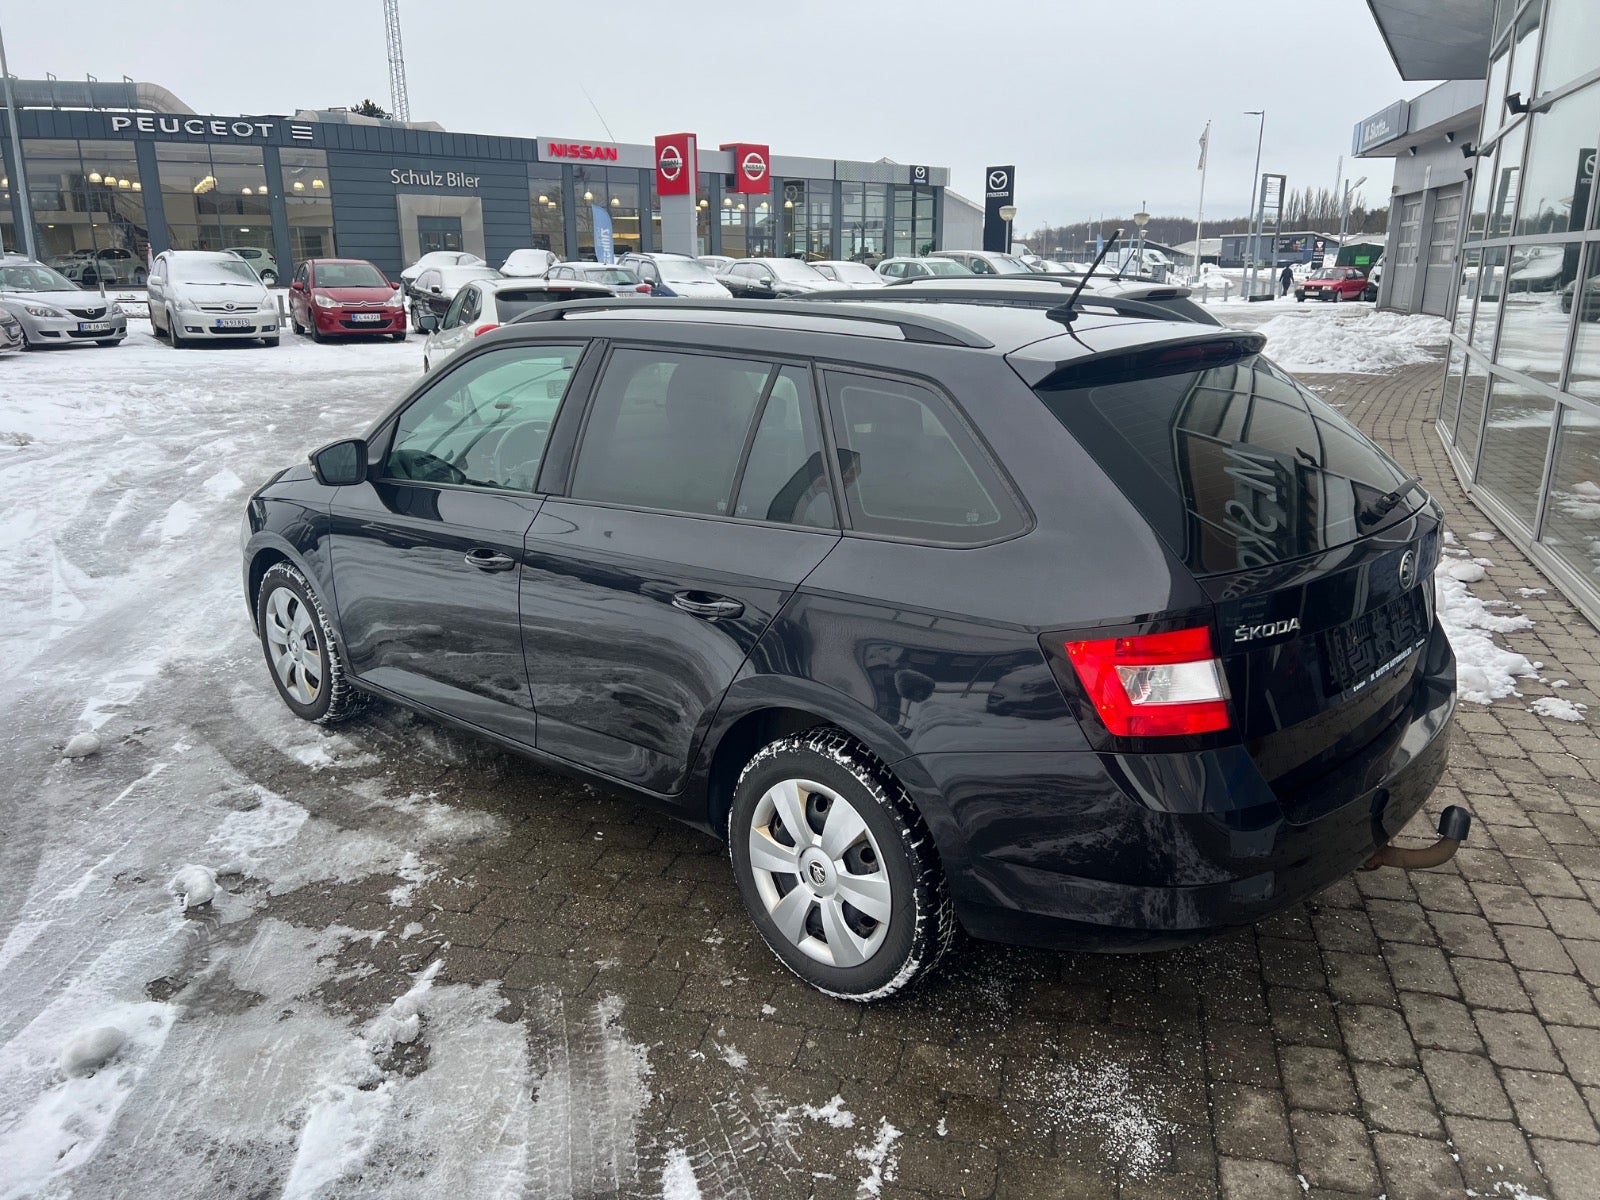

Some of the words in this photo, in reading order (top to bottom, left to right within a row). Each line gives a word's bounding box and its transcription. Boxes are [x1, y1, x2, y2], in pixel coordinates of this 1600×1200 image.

[111, 116, 273, 138] PEUGEOT
[548, 142, 618, 161] NISSAN
[390, 168, 443, 186] Schulz
[446, 172, 480, 188] Biler
[1234, 616, 1301, 642] ŠKODA
